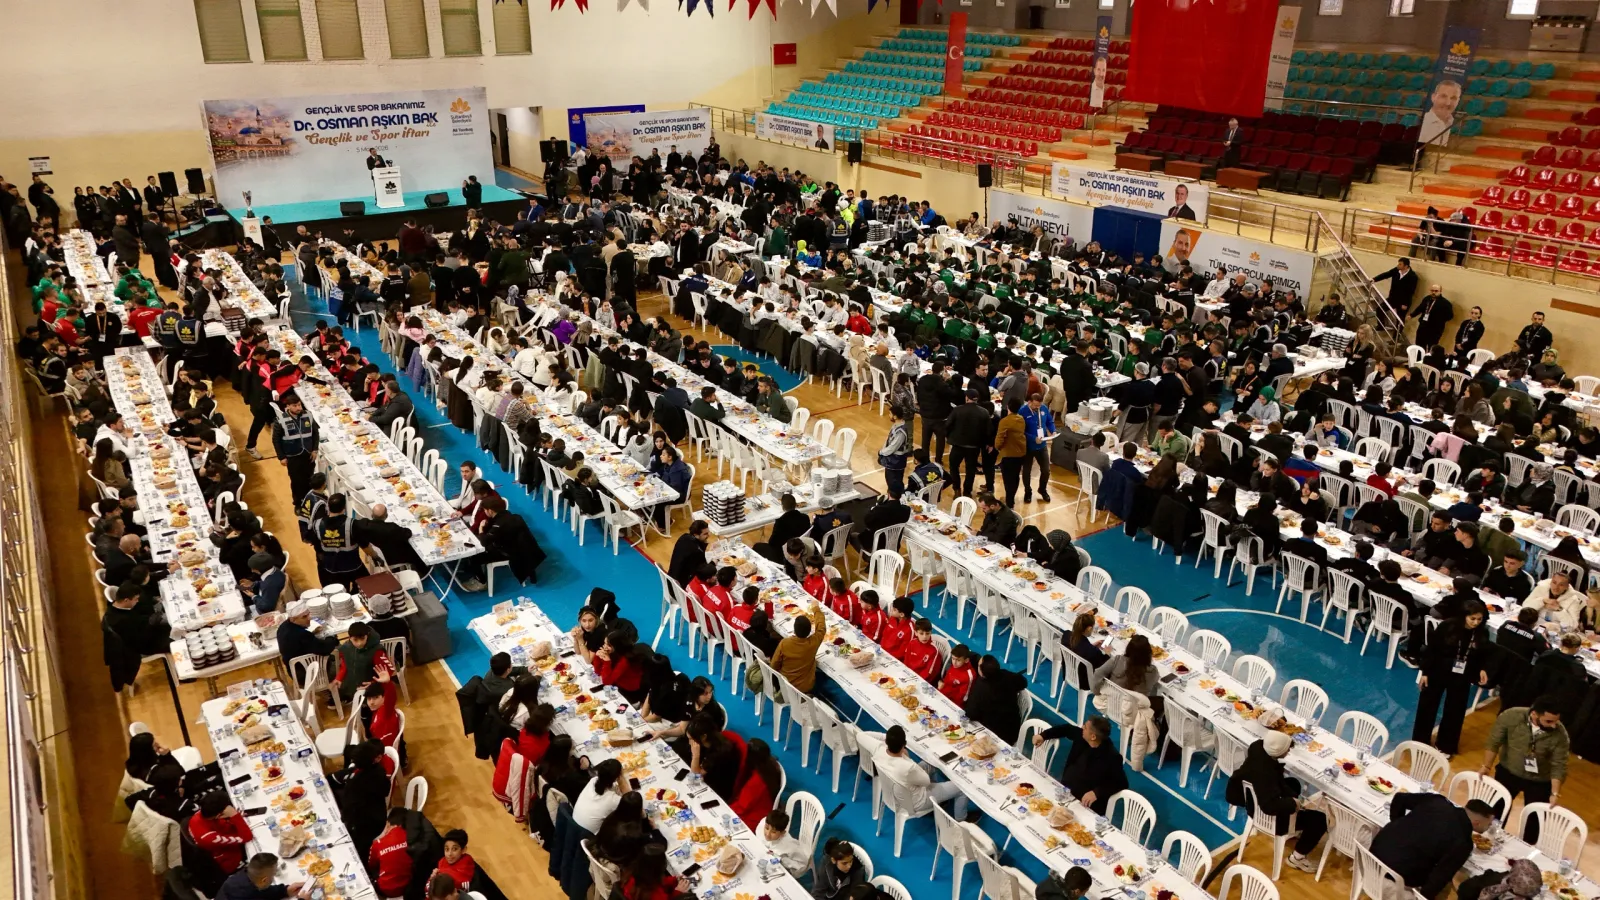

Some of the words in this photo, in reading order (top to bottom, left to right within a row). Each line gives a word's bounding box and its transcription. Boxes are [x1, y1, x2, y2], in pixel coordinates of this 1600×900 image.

[306, 104, 343, 116] GENÇLİK
[358, 104, 379, 112] SPOR
[381, 102, 425, 110] BAKANIMIZ
[294, 120, 314, 132] Dr.
[317, 118, 368, 130] OSMAN
[372, 114, 409, 129] AŞKIN
[412, 112, 439, 124] BAK
[645, 126, 670, 134] OSMAN
[672, 124, 691, 133] AŞKIN
[305, 132, 352, 146] Gençlik
[370, 129, 399, 143] Spor
[1087, 171, 1108, 180] GENÇLİK
[1080, 178, 1090, 188] Dr.
[1092, 180, 1120, 192] OSMAN
[1122, 186, 1145, 197] AŞKIN
[1148, 190, 1165, 200] BAK
